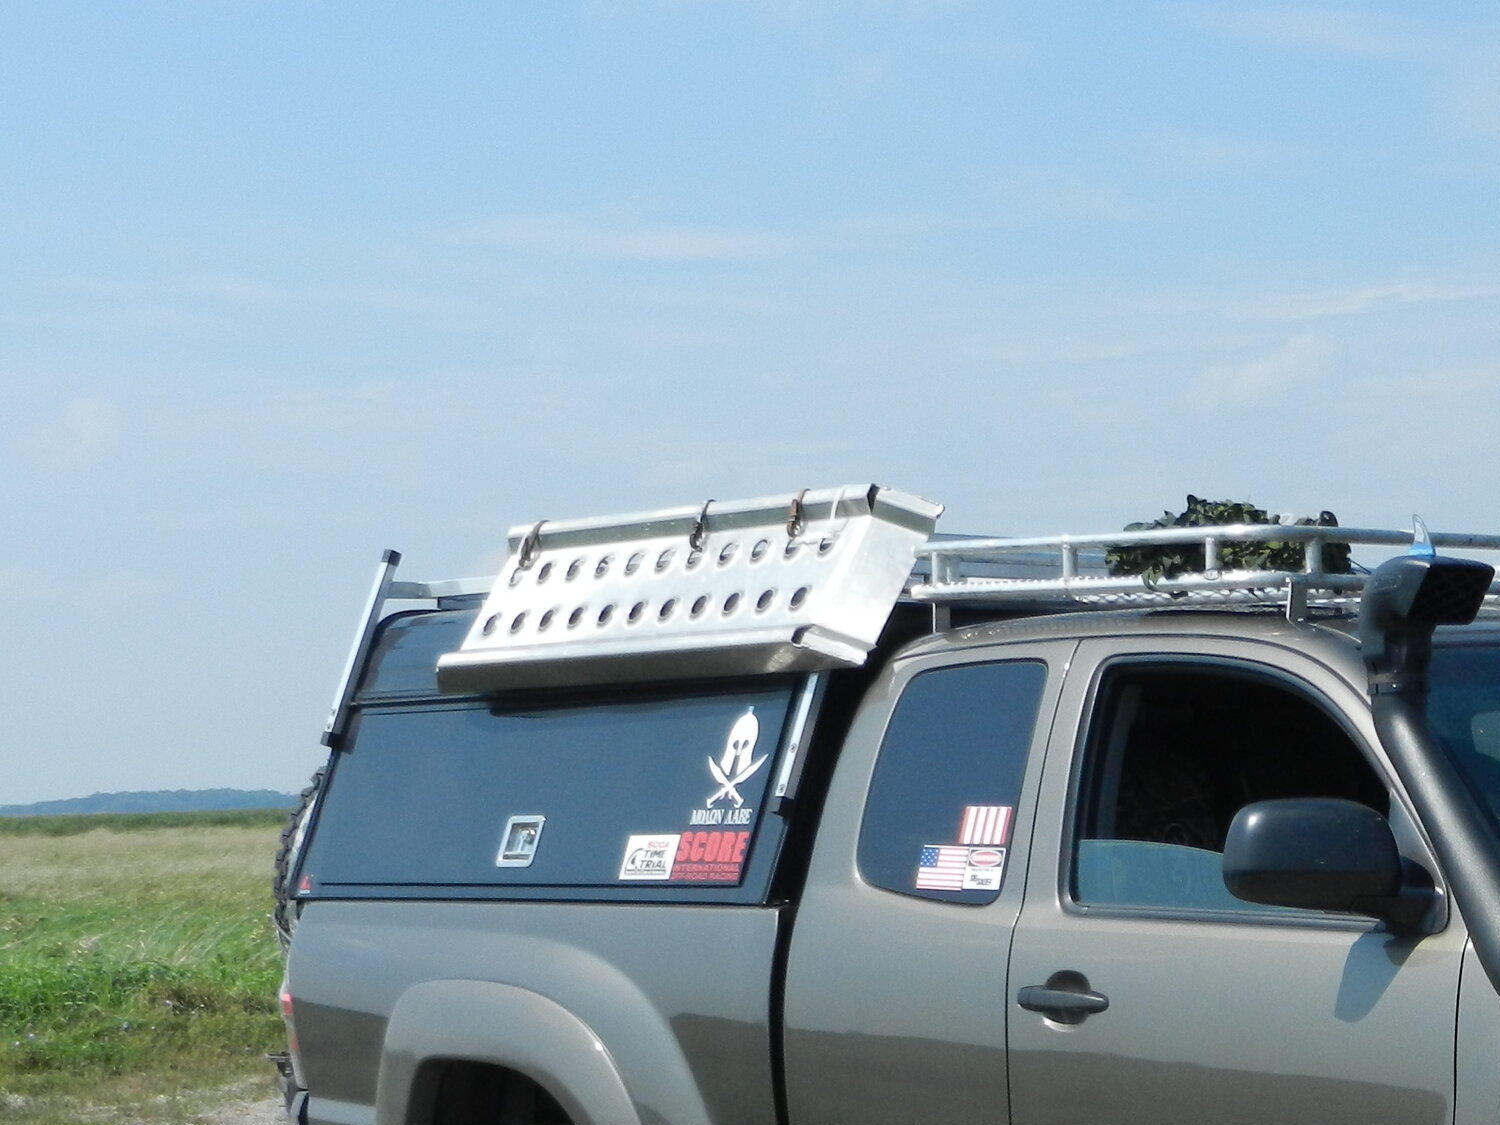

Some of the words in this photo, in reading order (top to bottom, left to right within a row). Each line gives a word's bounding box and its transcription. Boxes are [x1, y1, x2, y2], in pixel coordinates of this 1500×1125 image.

[676, 831, 751, 862] SCORE
[644, 850, 667, 858] TIME
[639, 860, 667, 869] TRIAL
